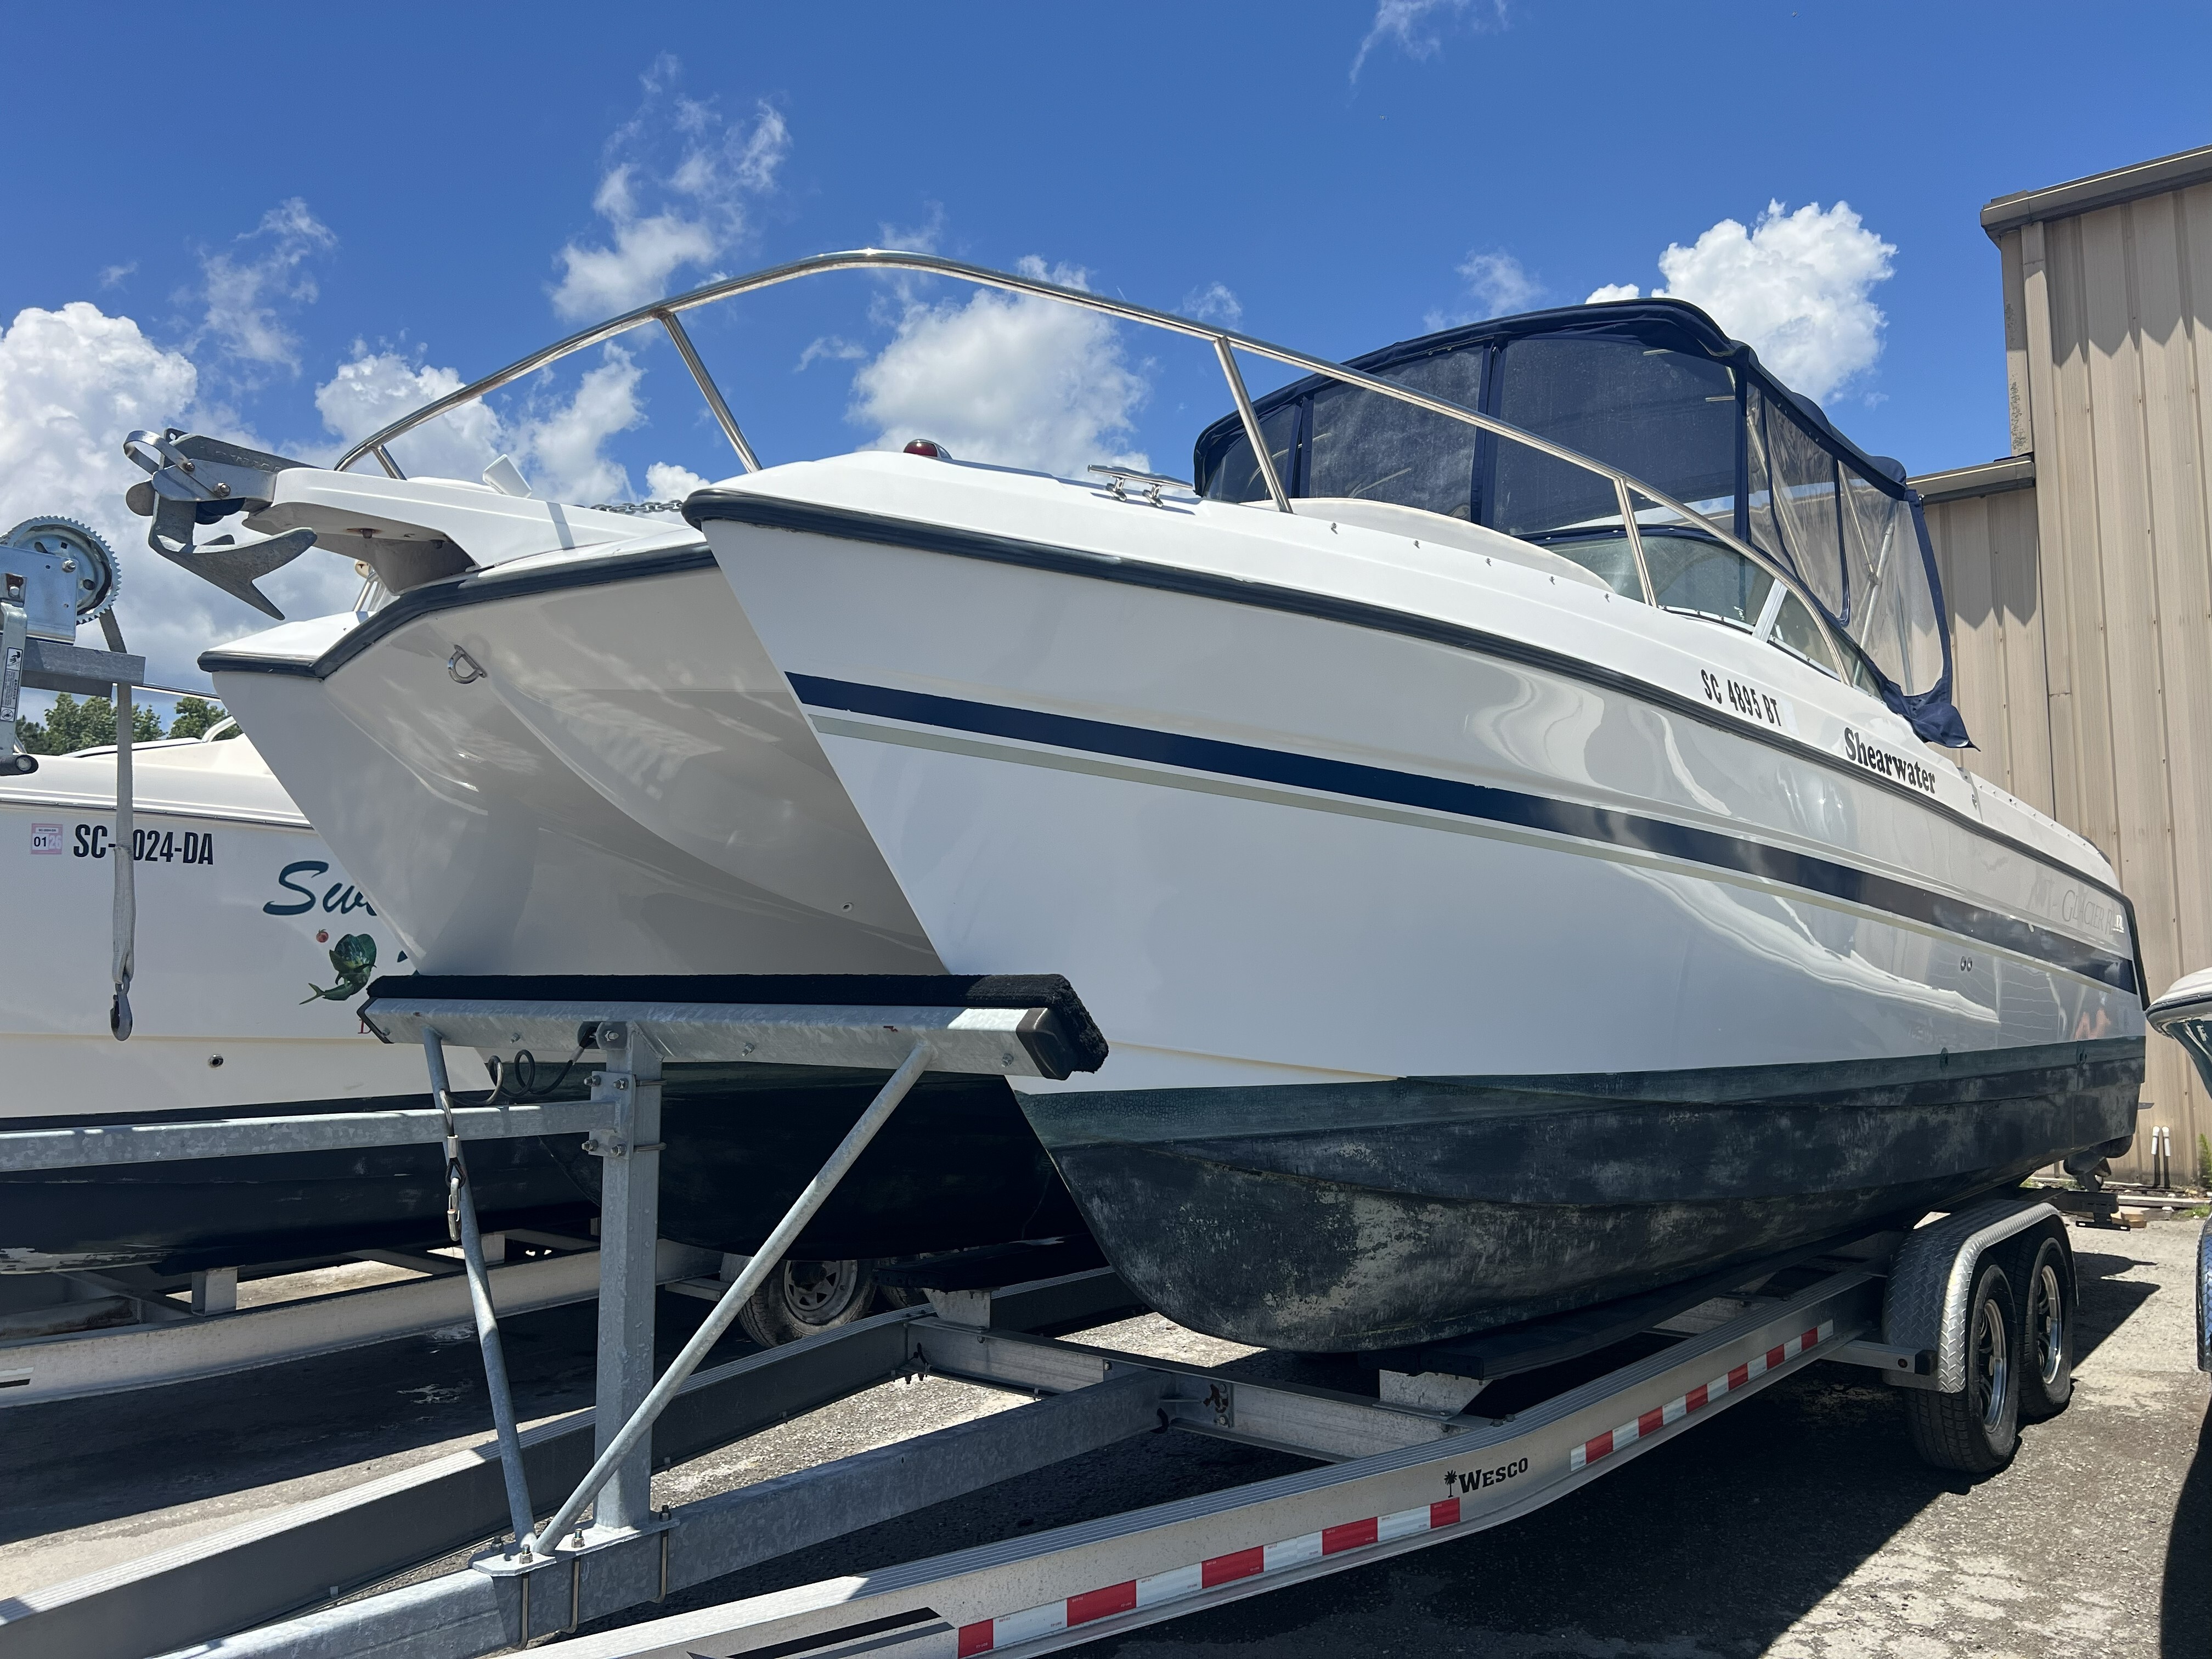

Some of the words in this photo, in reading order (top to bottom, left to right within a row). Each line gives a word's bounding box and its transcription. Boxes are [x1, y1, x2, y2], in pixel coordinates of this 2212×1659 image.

[1701, 669, 1722, 704] SC
[1727, 679, 1762, 719] 4895
[1761, 693, 1782, 727] BT
[1844, 727, 1936, 794] Shearwater
[33, 836, 47, 848] 01
[48, 834, 63, 850] 26
[73, 823, 213, 865] SC-024-DA
